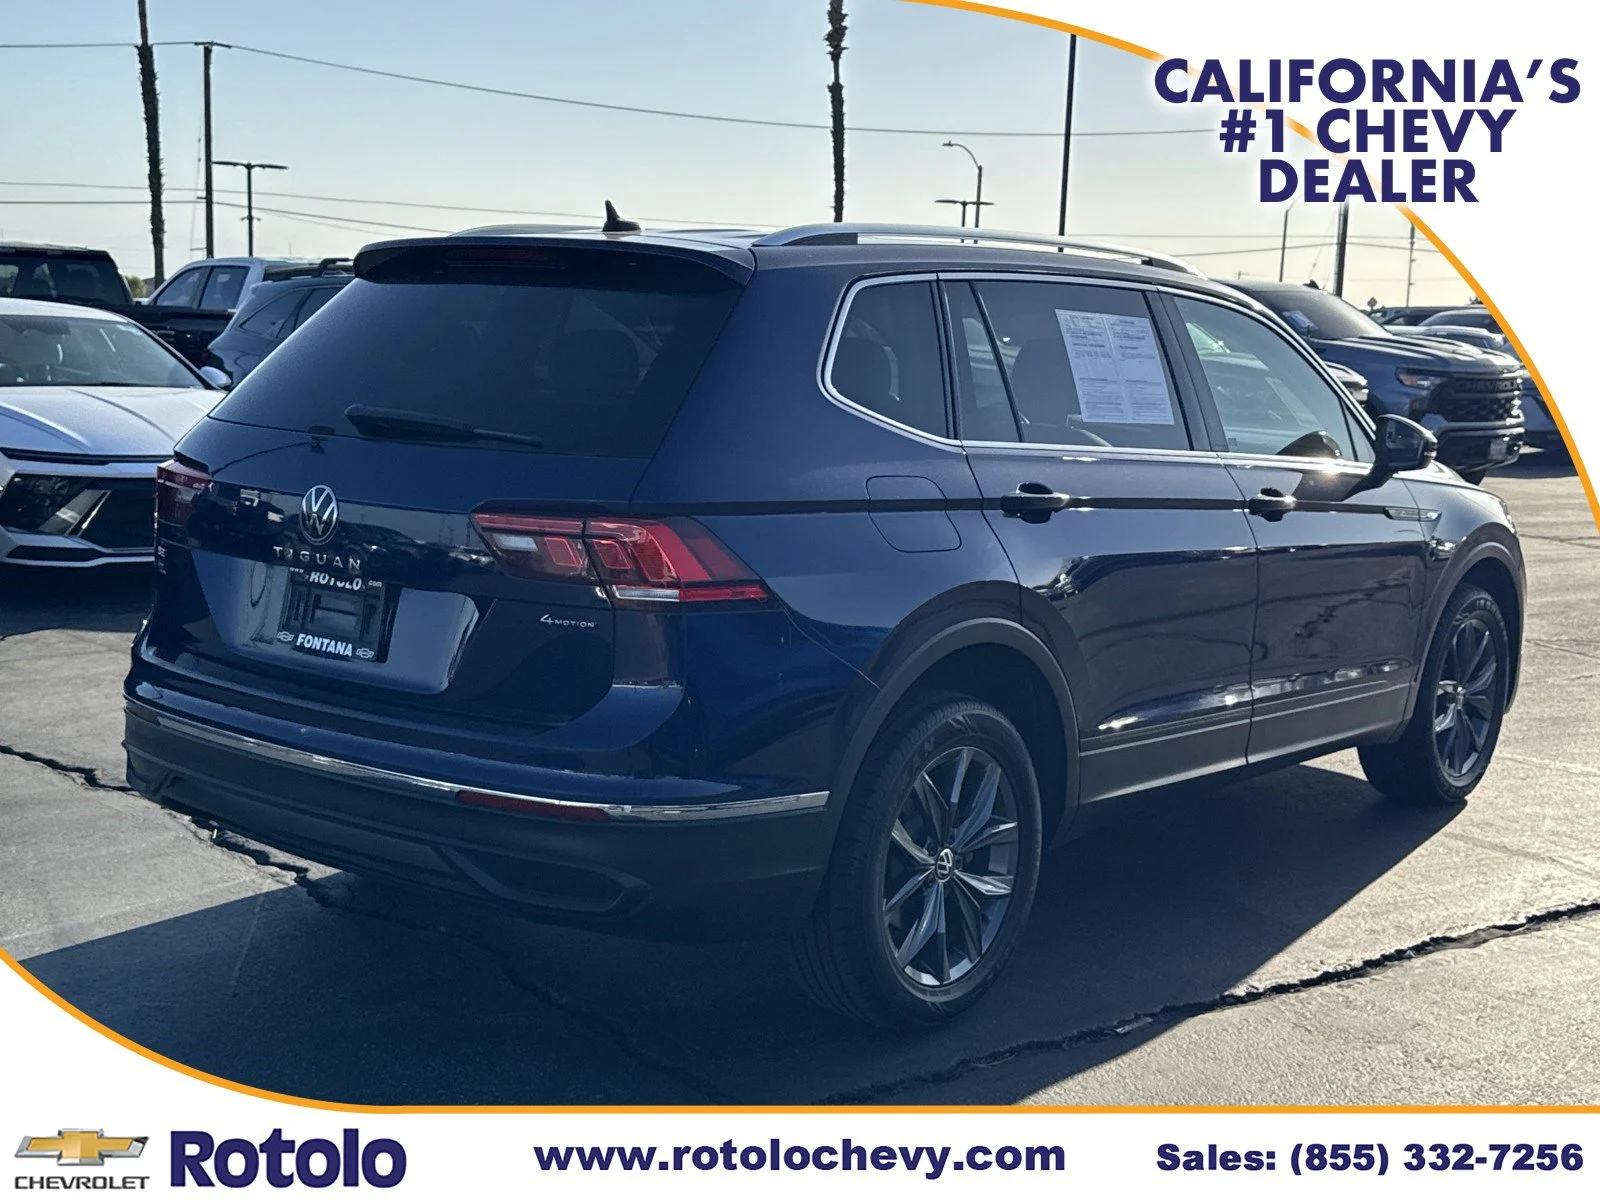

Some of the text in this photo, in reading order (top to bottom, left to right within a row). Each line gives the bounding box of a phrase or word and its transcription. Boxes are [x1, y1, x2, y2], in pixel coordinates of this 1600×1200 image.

[272, 545, 361, 571] TIGUAN
[539, 613, 595, 628] 4MOTION
[295, 632, 353, 657] FONTANA
